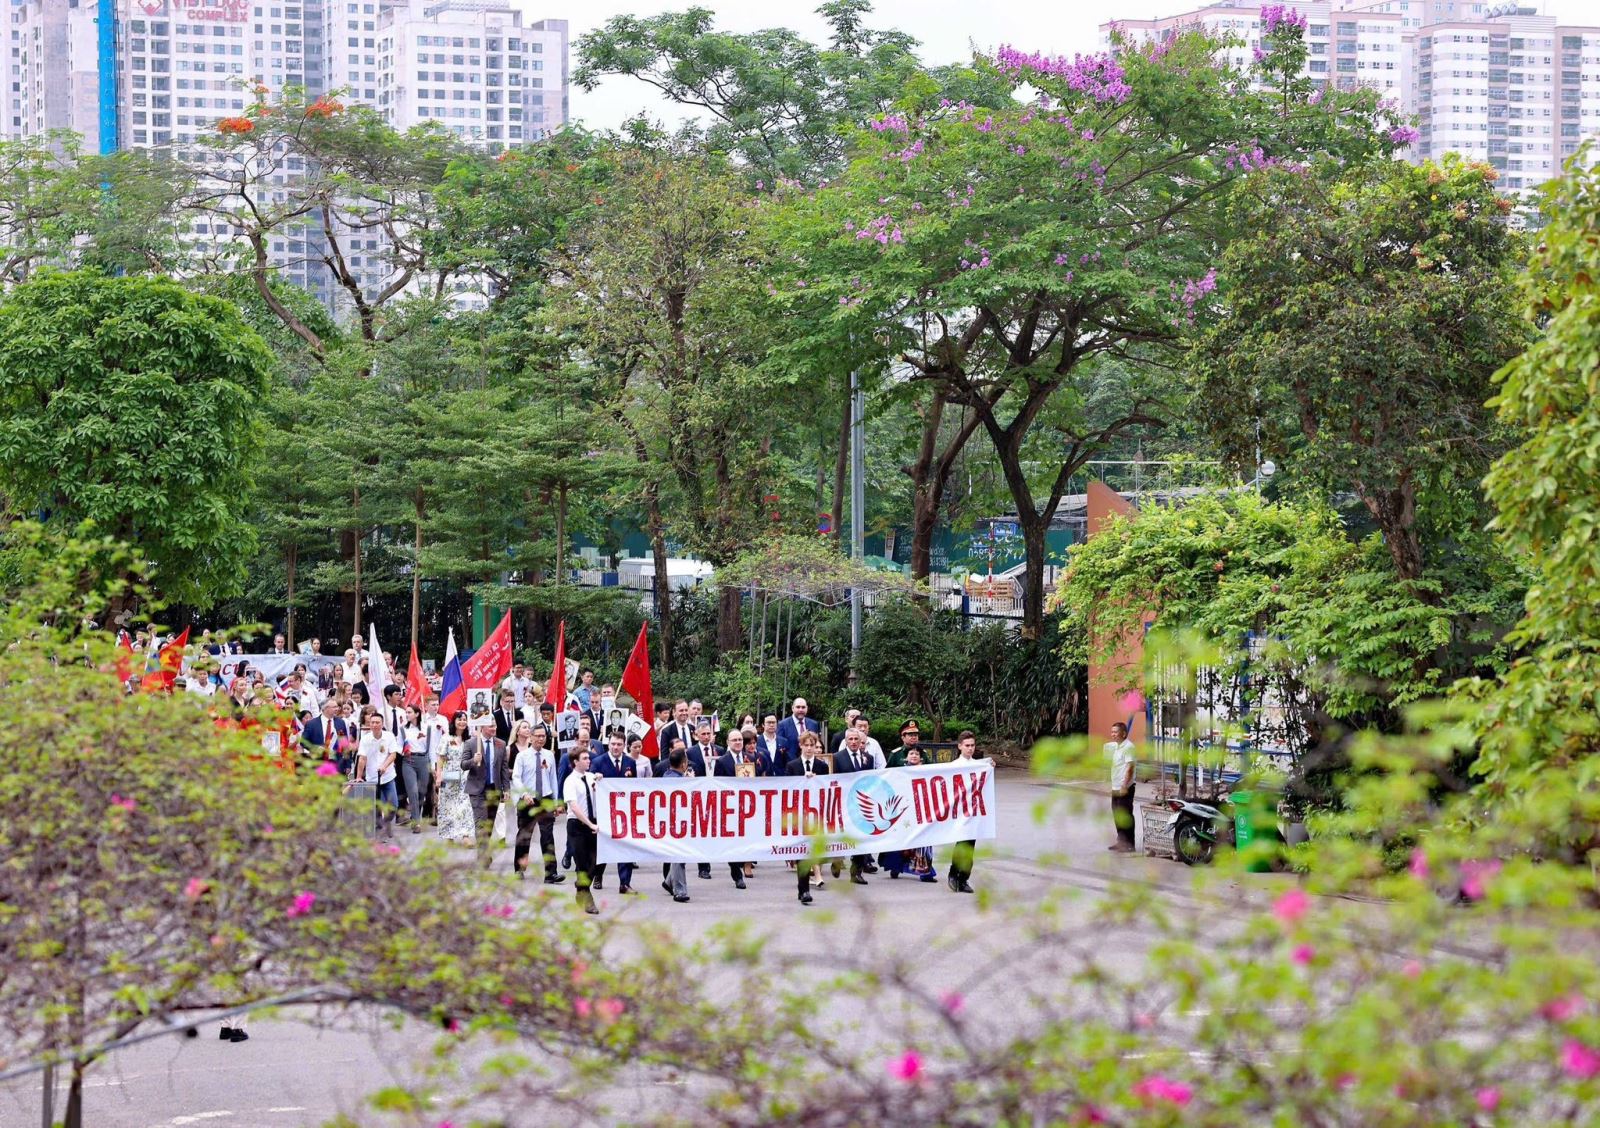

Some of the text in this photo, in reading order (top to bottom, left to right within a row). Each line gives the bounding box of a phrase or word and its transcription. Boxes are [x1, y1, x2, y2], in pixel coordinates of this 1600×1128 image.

[187, 9, 248, 22] COMPLEX
[608, 771, 987, 839] БЕССМЕРТНЫЙ ПОЛК
